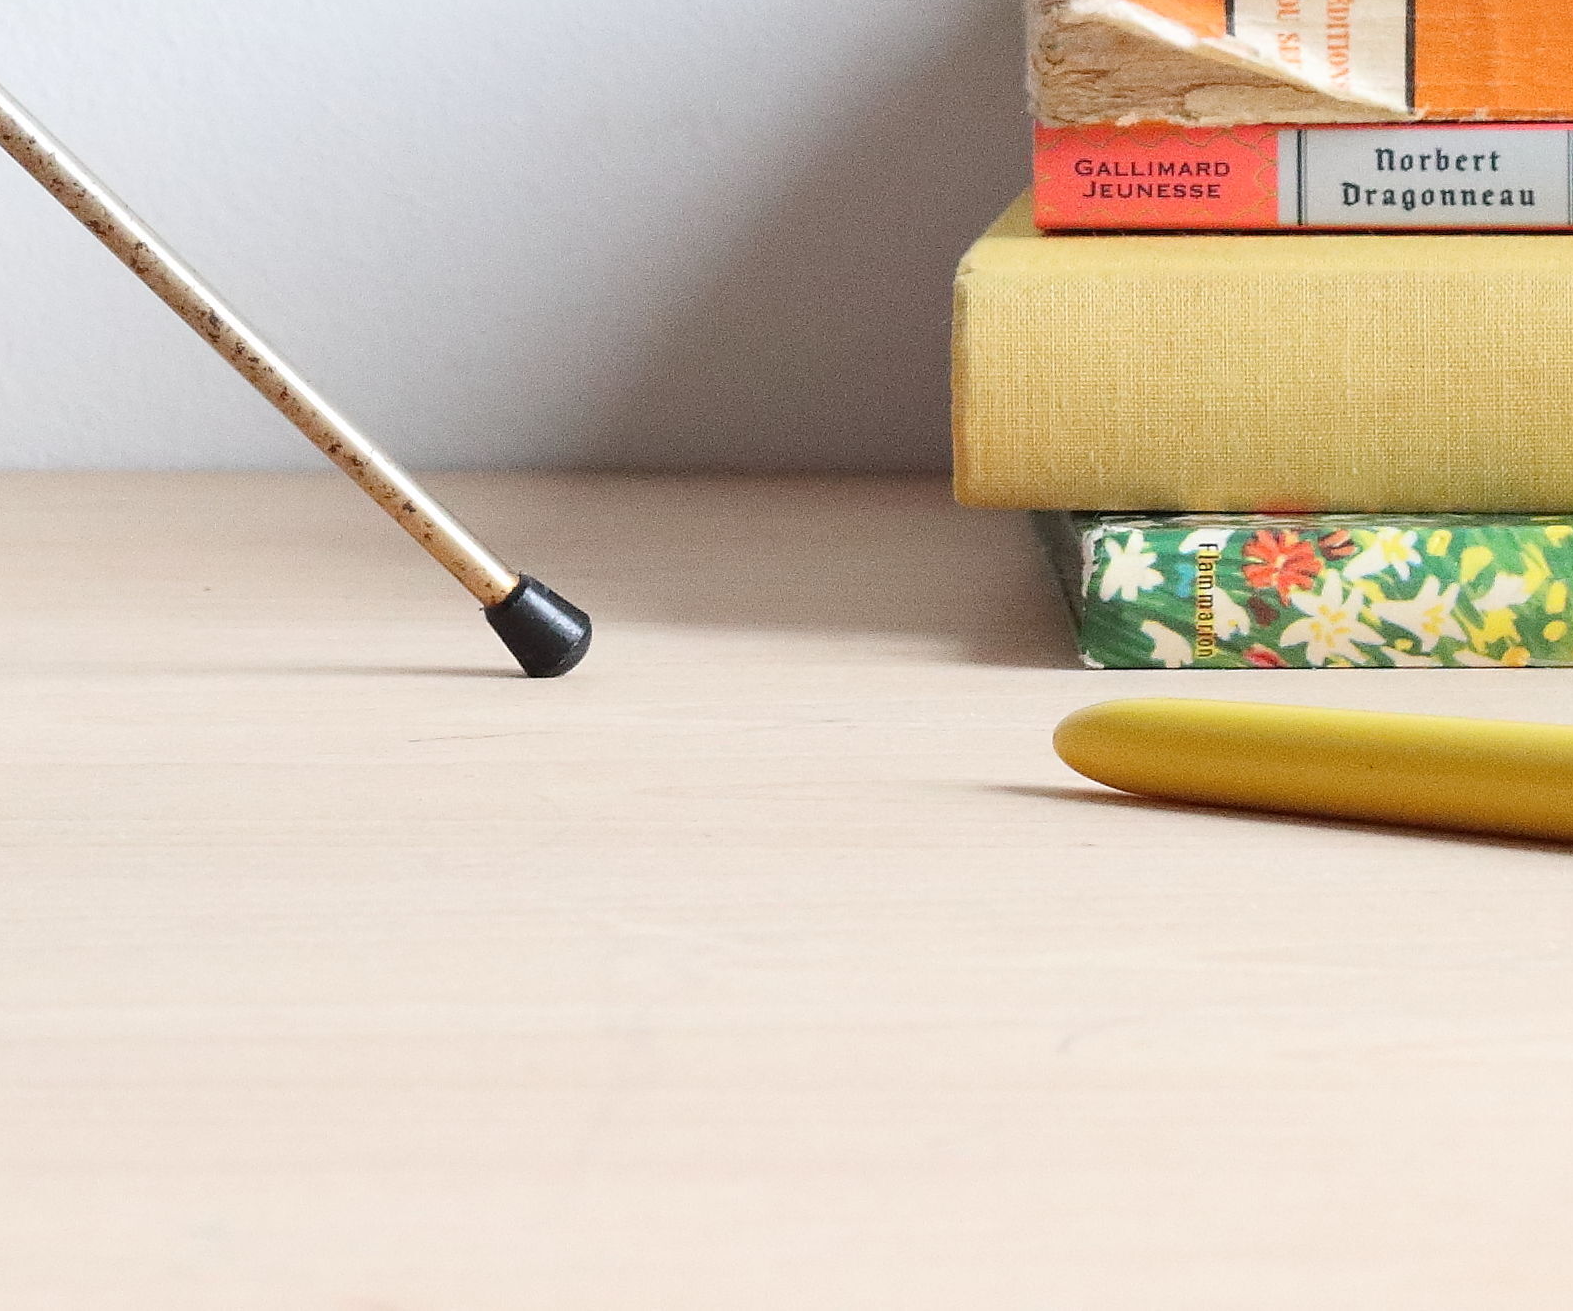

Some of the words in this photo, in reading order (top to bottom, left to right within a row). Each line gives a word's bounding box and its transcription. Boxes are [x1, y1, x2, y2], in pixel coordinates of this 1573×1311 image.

[1073, 158, 1231, 179] GALLIMARD
[1374, 147, 1502, 174] Norbert
[1083, 179, 1221, 200] JEUNESSE
[1341, 181, 1537, 210] Dragonneau
[1198, 543, 1219, 658] Flammarion
